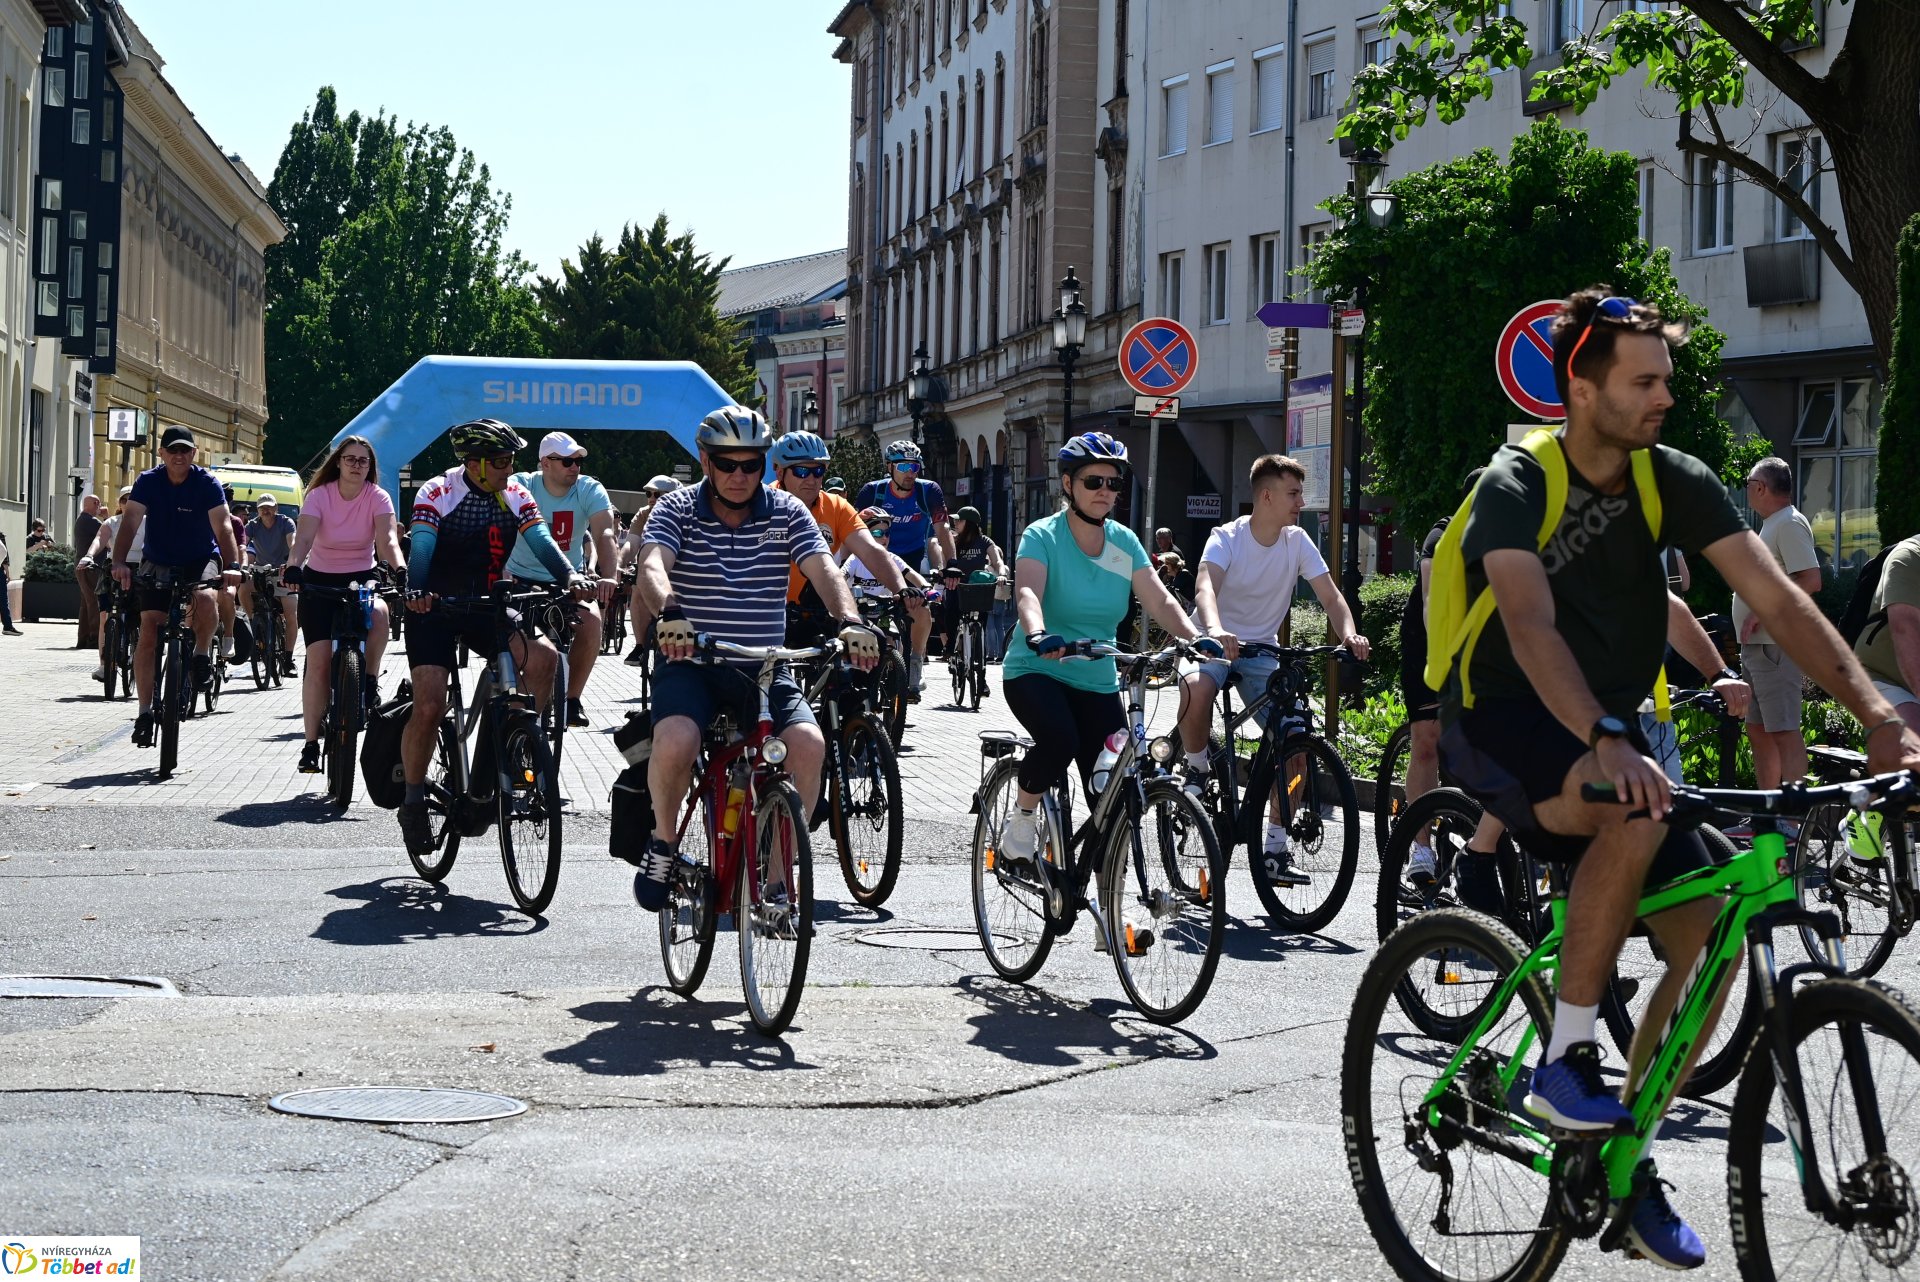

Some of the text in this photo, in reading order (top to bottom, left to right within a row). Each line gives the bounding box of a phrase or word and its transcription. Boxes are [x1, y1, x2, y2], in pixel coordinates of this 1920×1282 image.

[483, 380, 642, 406] SHIMANO
[1187, 498, 1219, 507] VIGYÁZZ
[556, 521, 565, 536] J
[757, 528, 788, 545] SPORT
